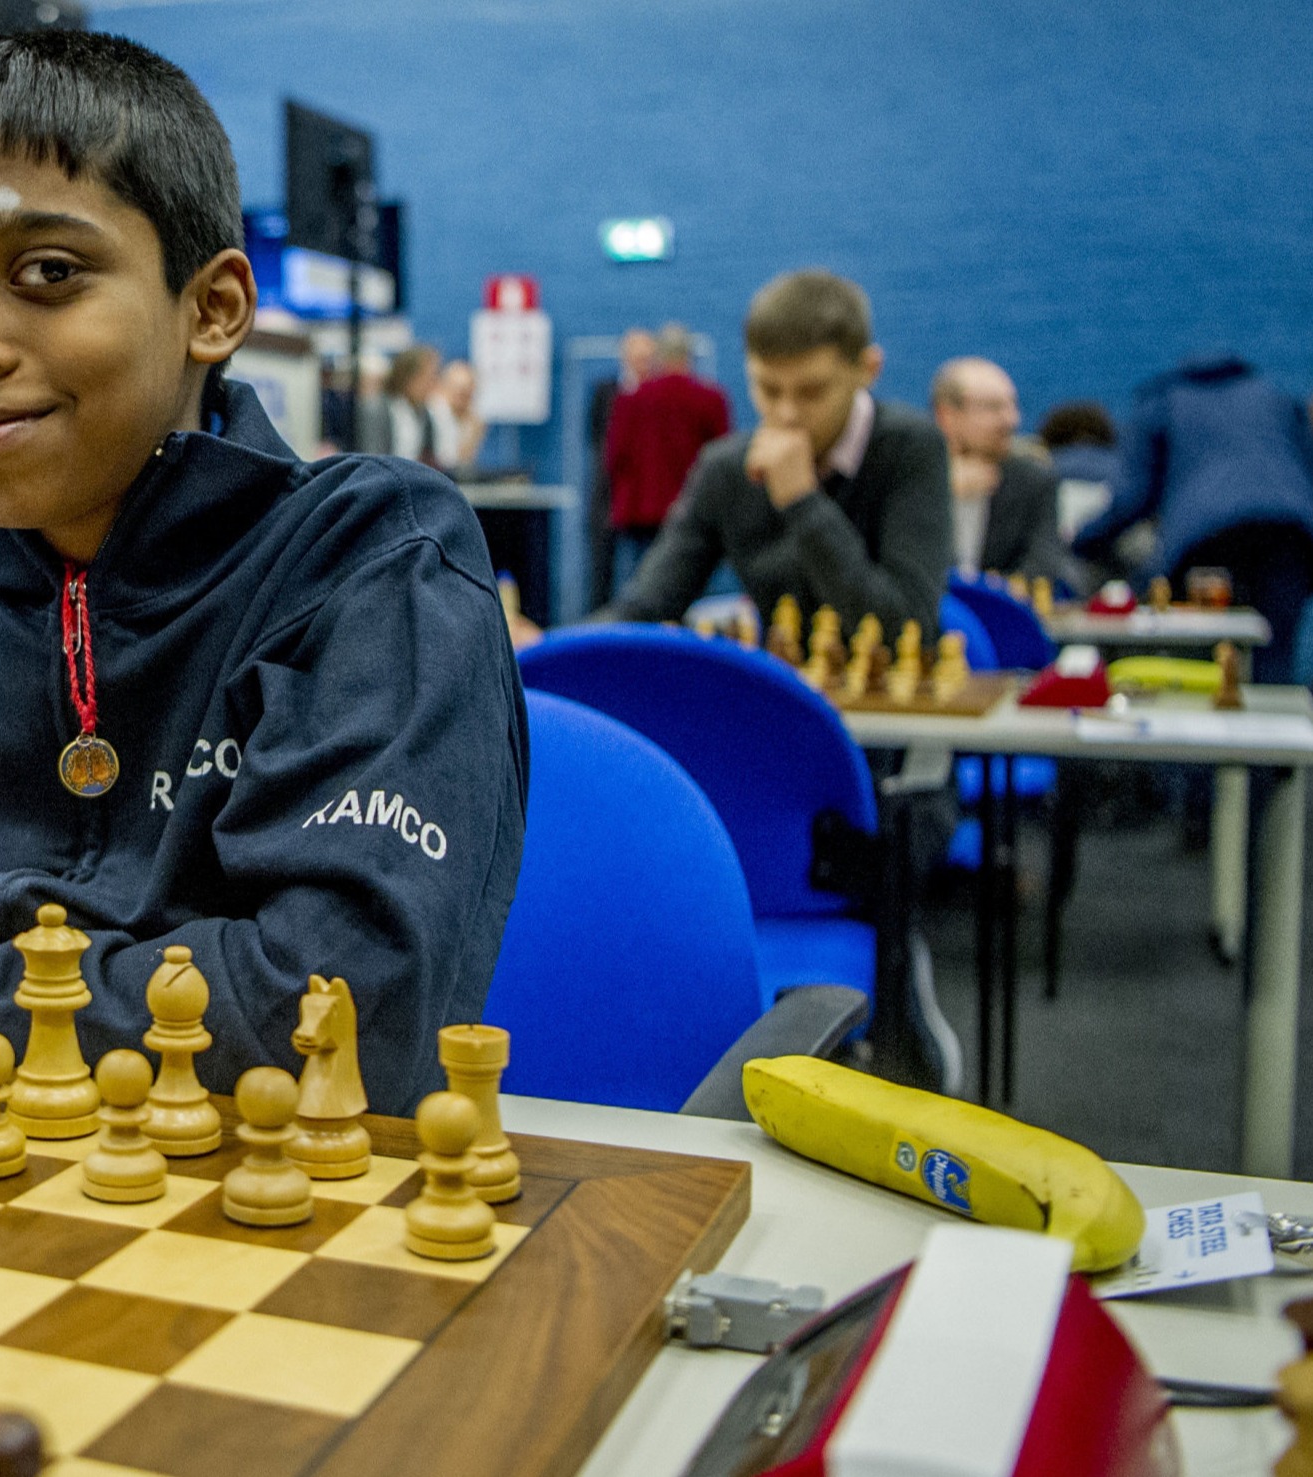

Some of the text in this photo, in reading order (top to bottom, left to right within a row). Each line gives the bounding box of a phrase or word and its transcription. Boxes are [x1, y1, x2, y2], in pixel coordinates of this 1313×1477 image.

[150, 738, 242, 811] RCO
[1168, 1208, 1194, 1240] CHESS
[1198, 1202, 1227, 1257] TATA STEEL
